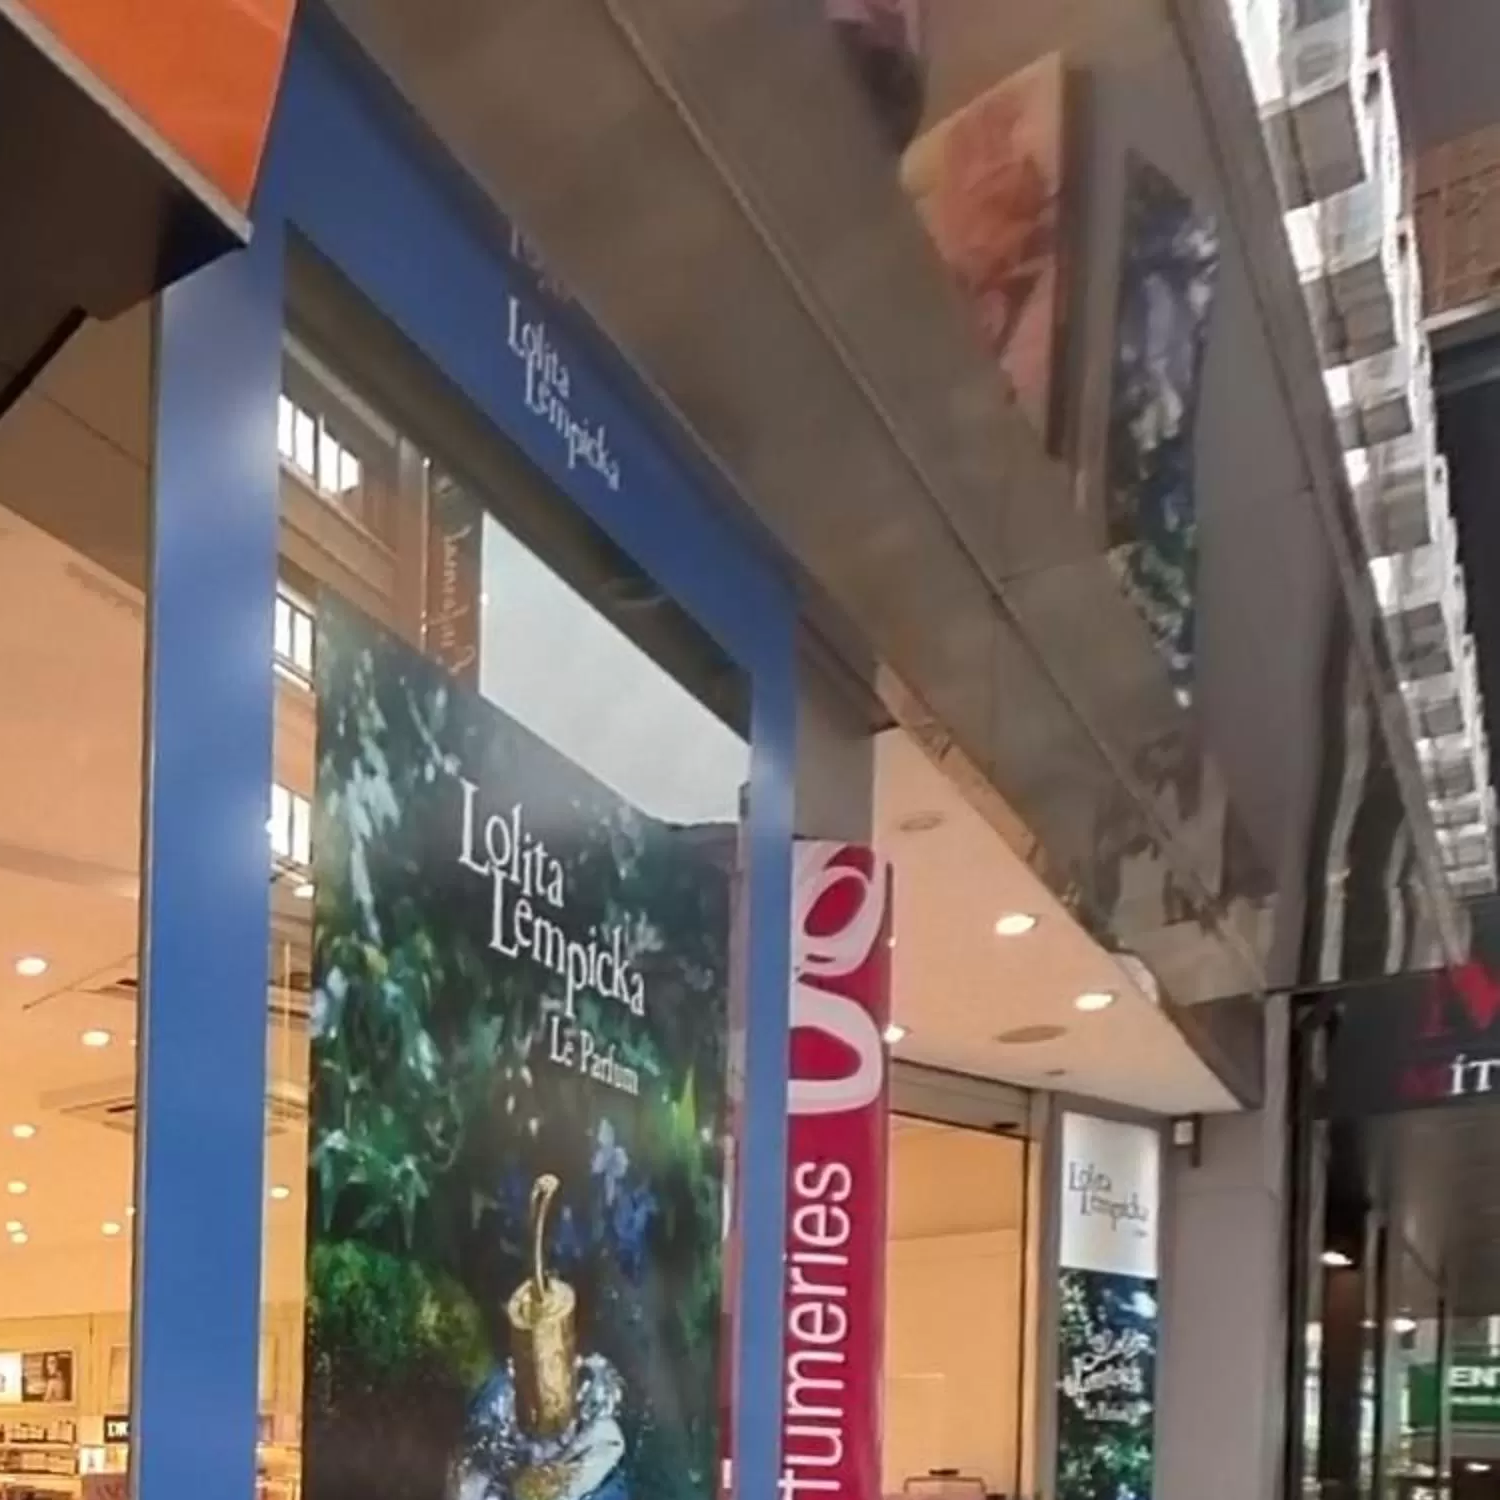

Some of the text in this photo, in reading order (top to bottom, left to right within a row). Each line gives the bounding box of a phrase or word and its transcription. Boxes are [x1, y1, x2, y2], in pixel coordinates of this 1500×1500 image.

[508, 296, 570, 400] Lolita
[523, 350, 621, 492] Lempicka
[459, 777, 565, 908] Lolita
[488, 866, 646, 1018] Lempicka
[550, 1015, 639, 1096] Le Parfum
